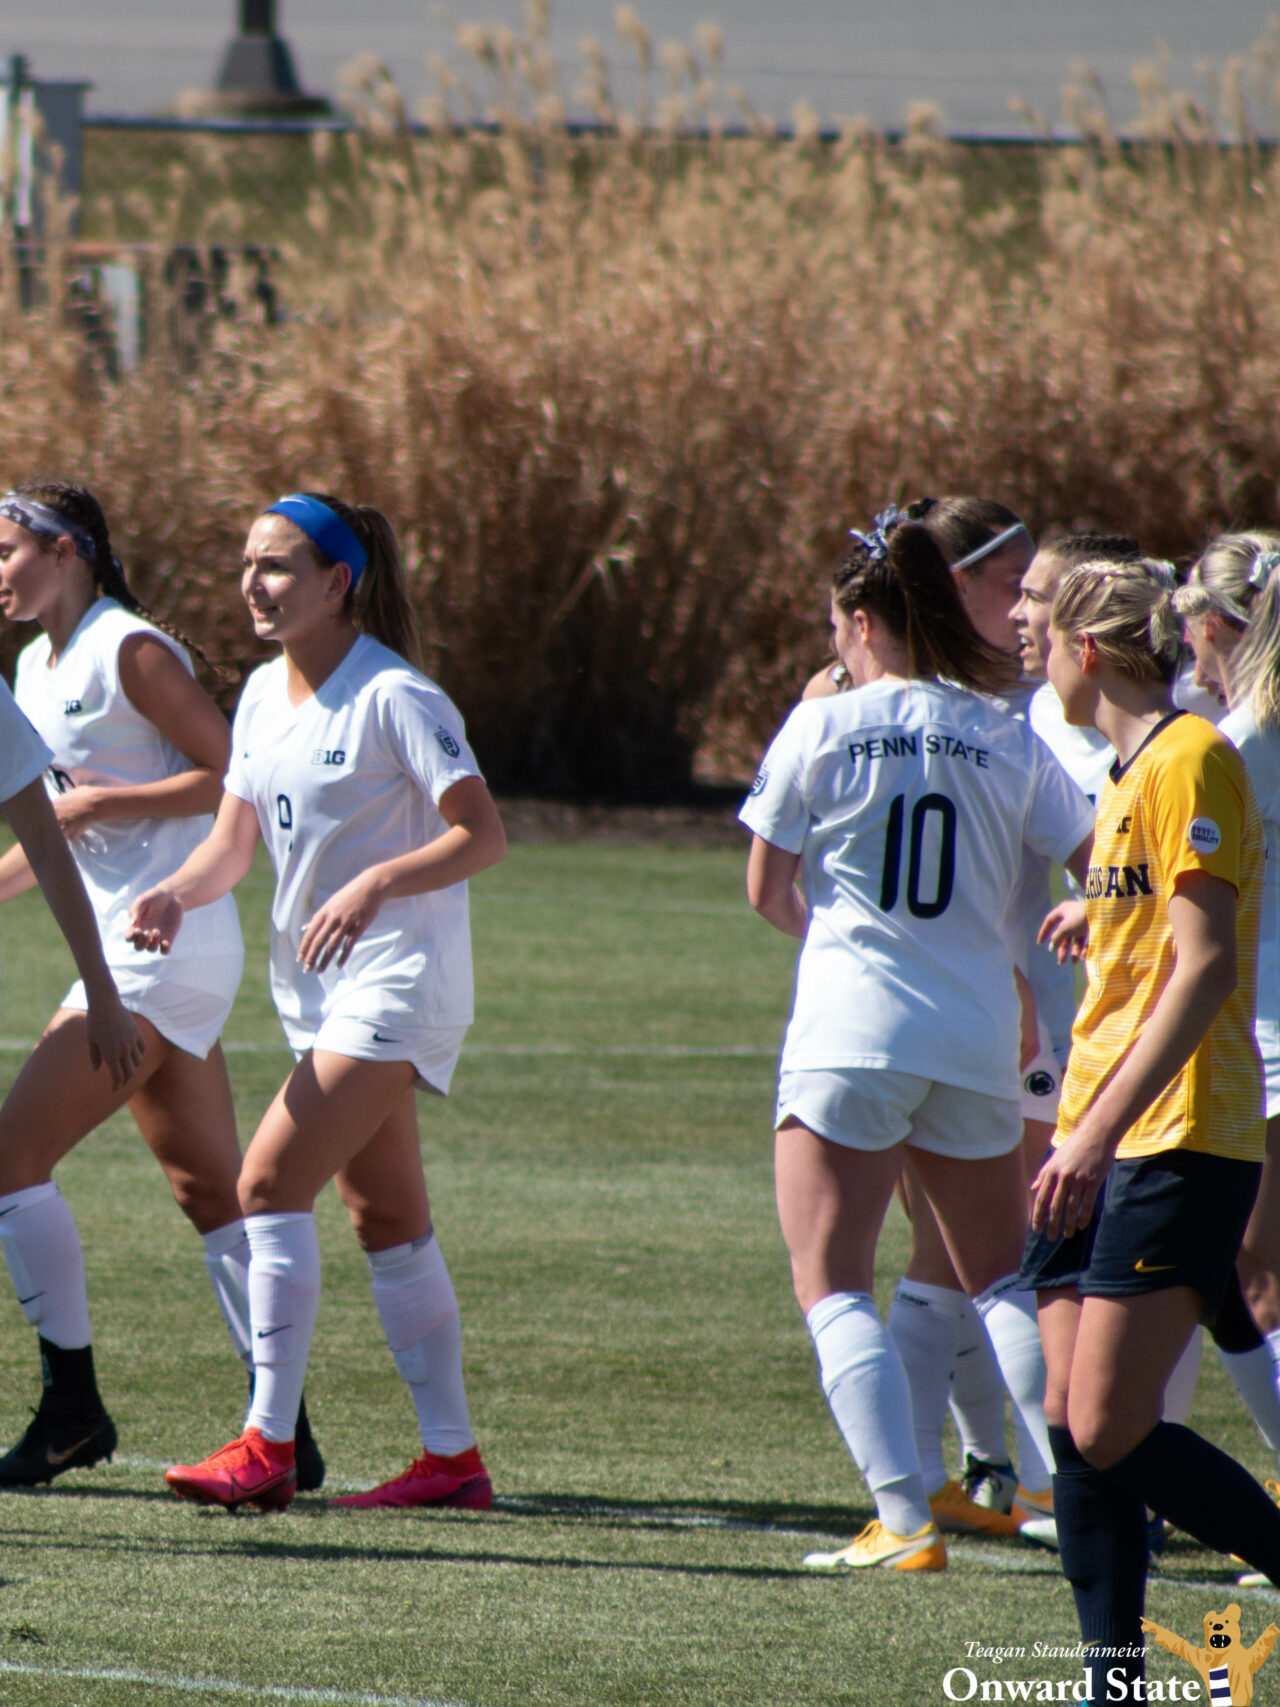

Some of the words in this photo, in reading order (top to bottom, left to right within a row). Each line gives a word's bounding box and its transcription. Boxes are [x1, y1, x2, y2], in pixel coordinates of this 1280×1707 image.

[849, 736, 918, 764] PENN
[925, 733, 990, 770] STATE
[879, 792, 957, 920] 10
